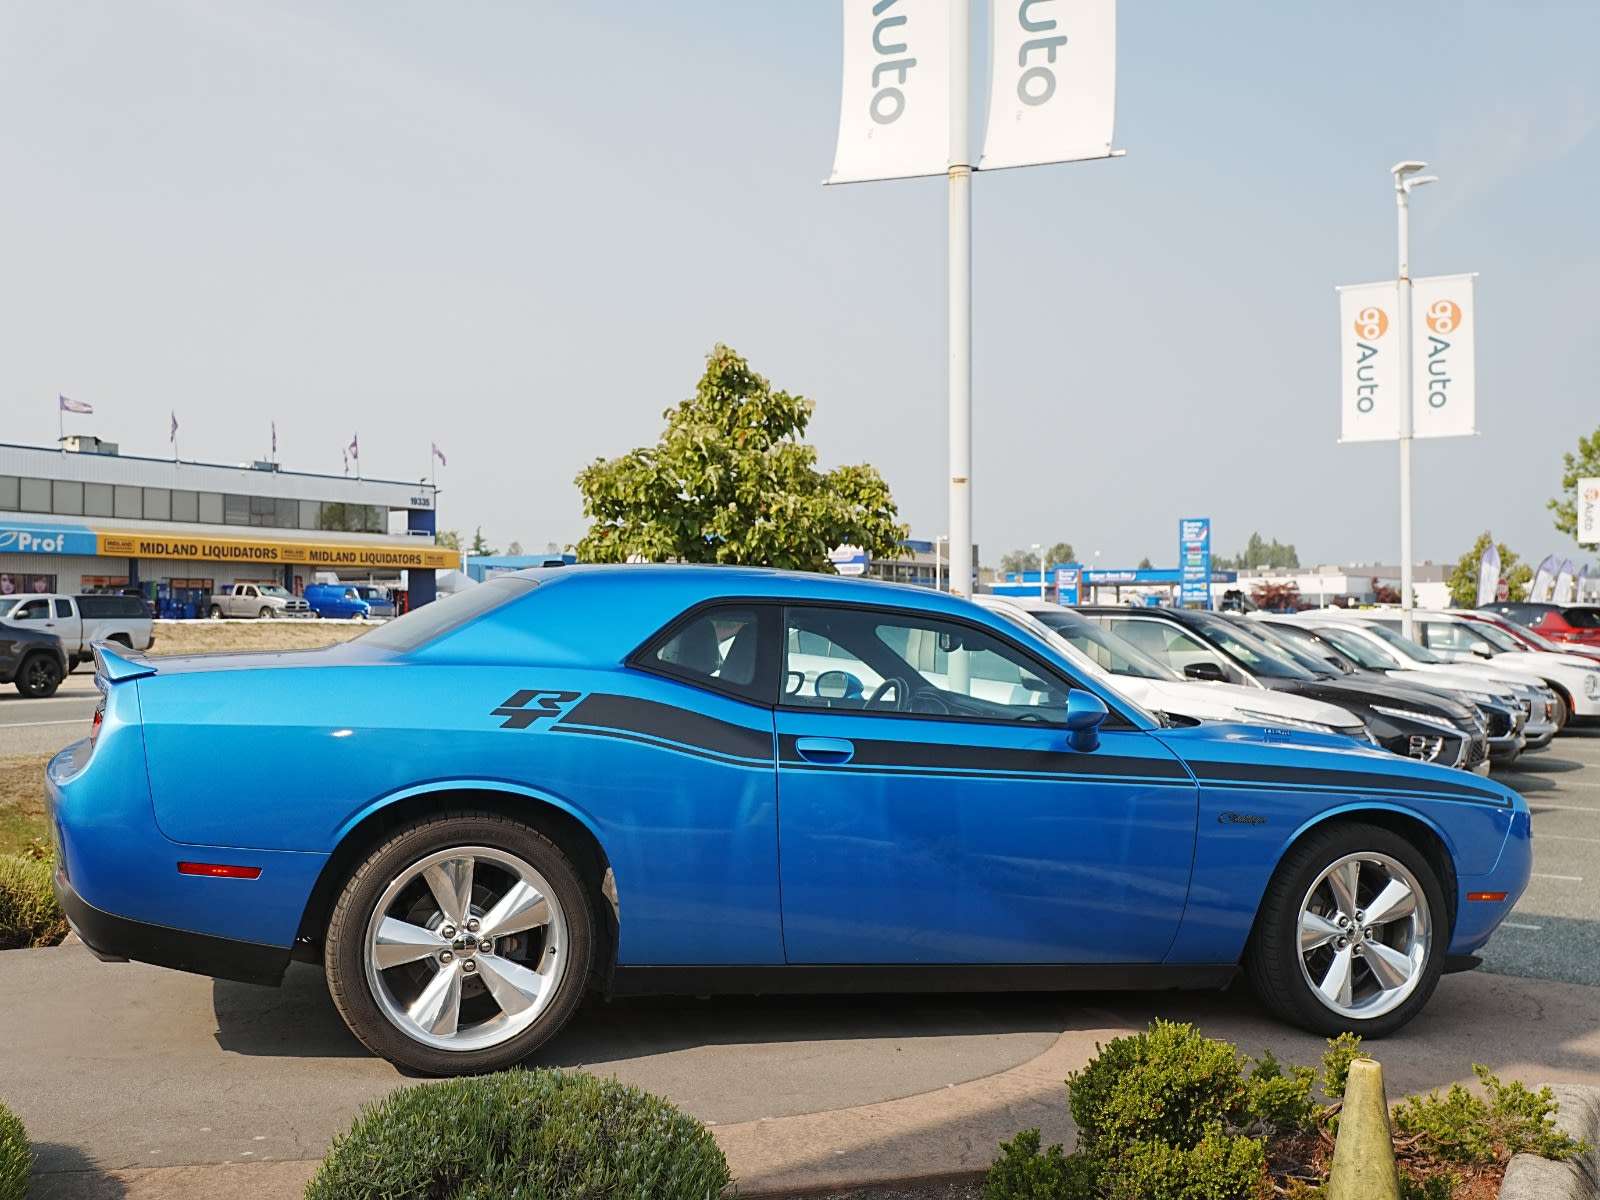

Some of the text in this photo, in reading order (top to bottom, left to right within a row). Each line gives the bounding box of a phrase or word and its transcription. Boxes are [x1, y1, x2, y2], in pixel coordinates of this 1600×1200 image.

[1355, 307, 1384, 413] go Auto
[1427, 300, 1457, 408] go Auto
[19, 532, 64, 552] Prof
[140, 542, 198, 556] MIDLAND
[202, 545, 278, 560] LIQUIDATORS
[309, 551, 356, 562] MIDLAND
[360, 552, 422, 565] LIQUIDATORS
